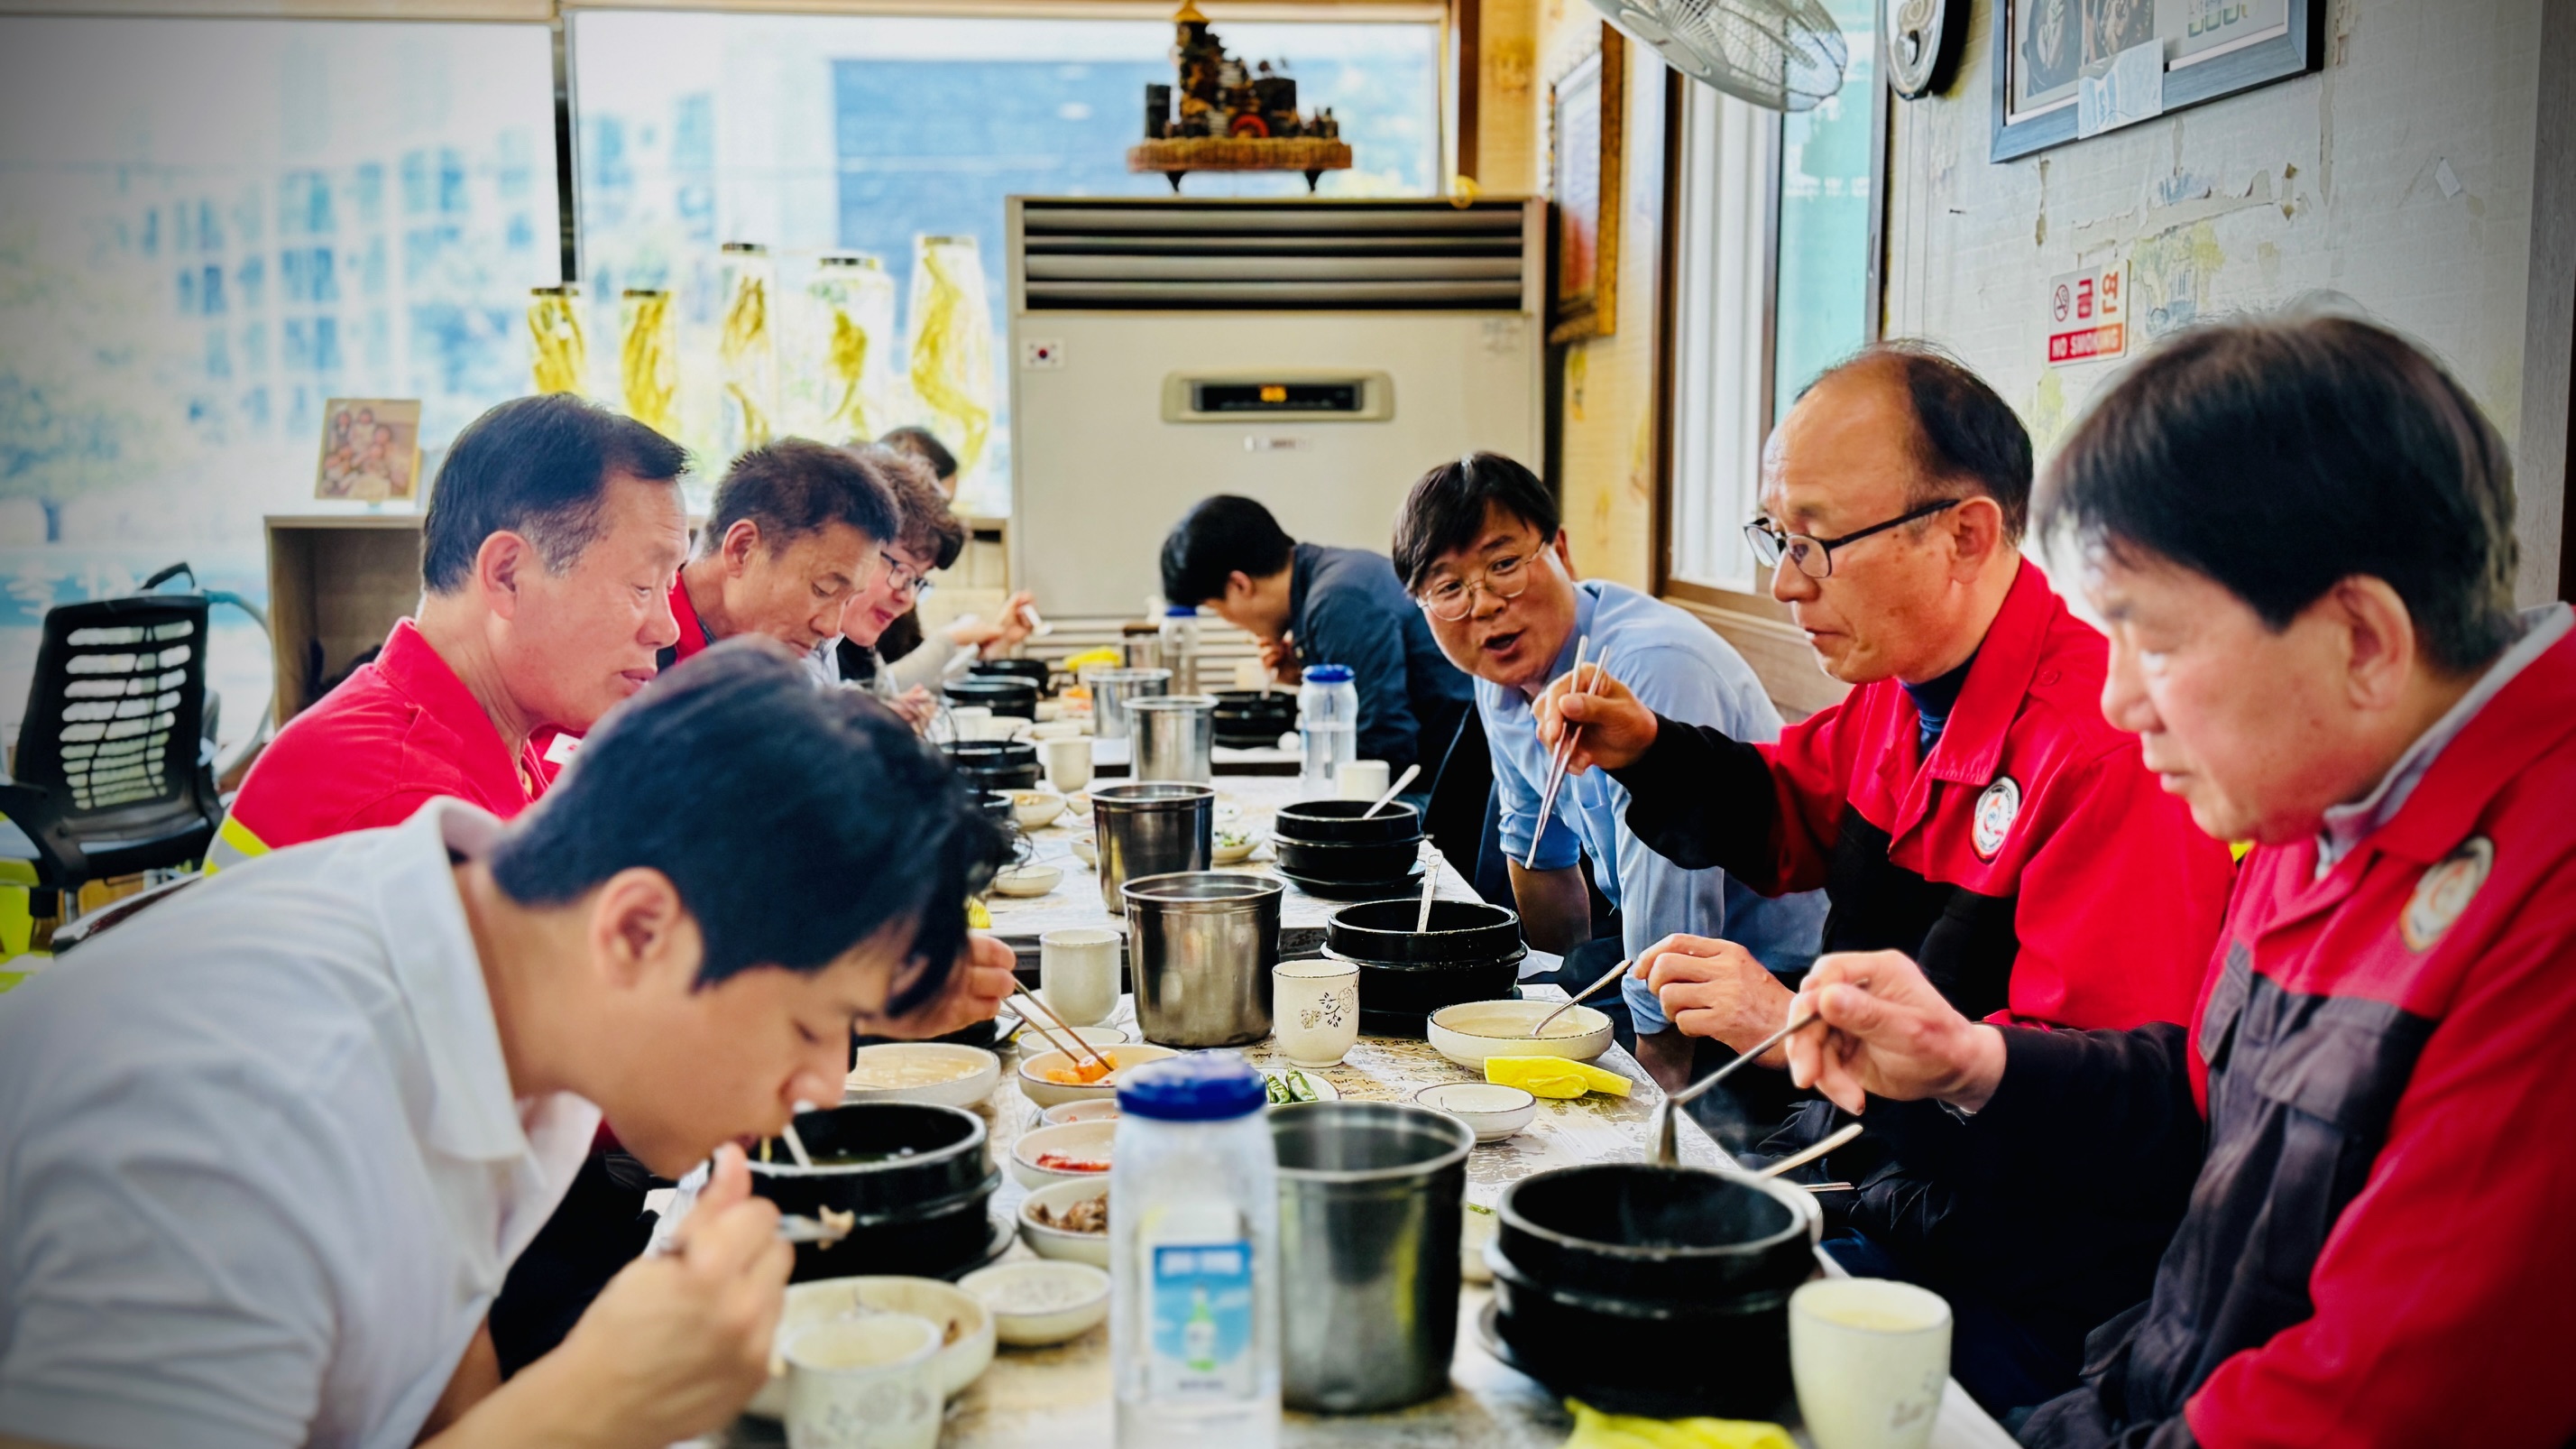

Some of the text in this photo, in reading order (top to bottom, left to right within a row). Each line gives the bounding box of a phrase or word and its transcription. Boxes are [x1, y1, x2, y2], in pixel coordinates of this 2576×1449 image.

[2077, 272, 2118, 318] 금연
[2052, 328, 2119, 358] NO SMOKING
